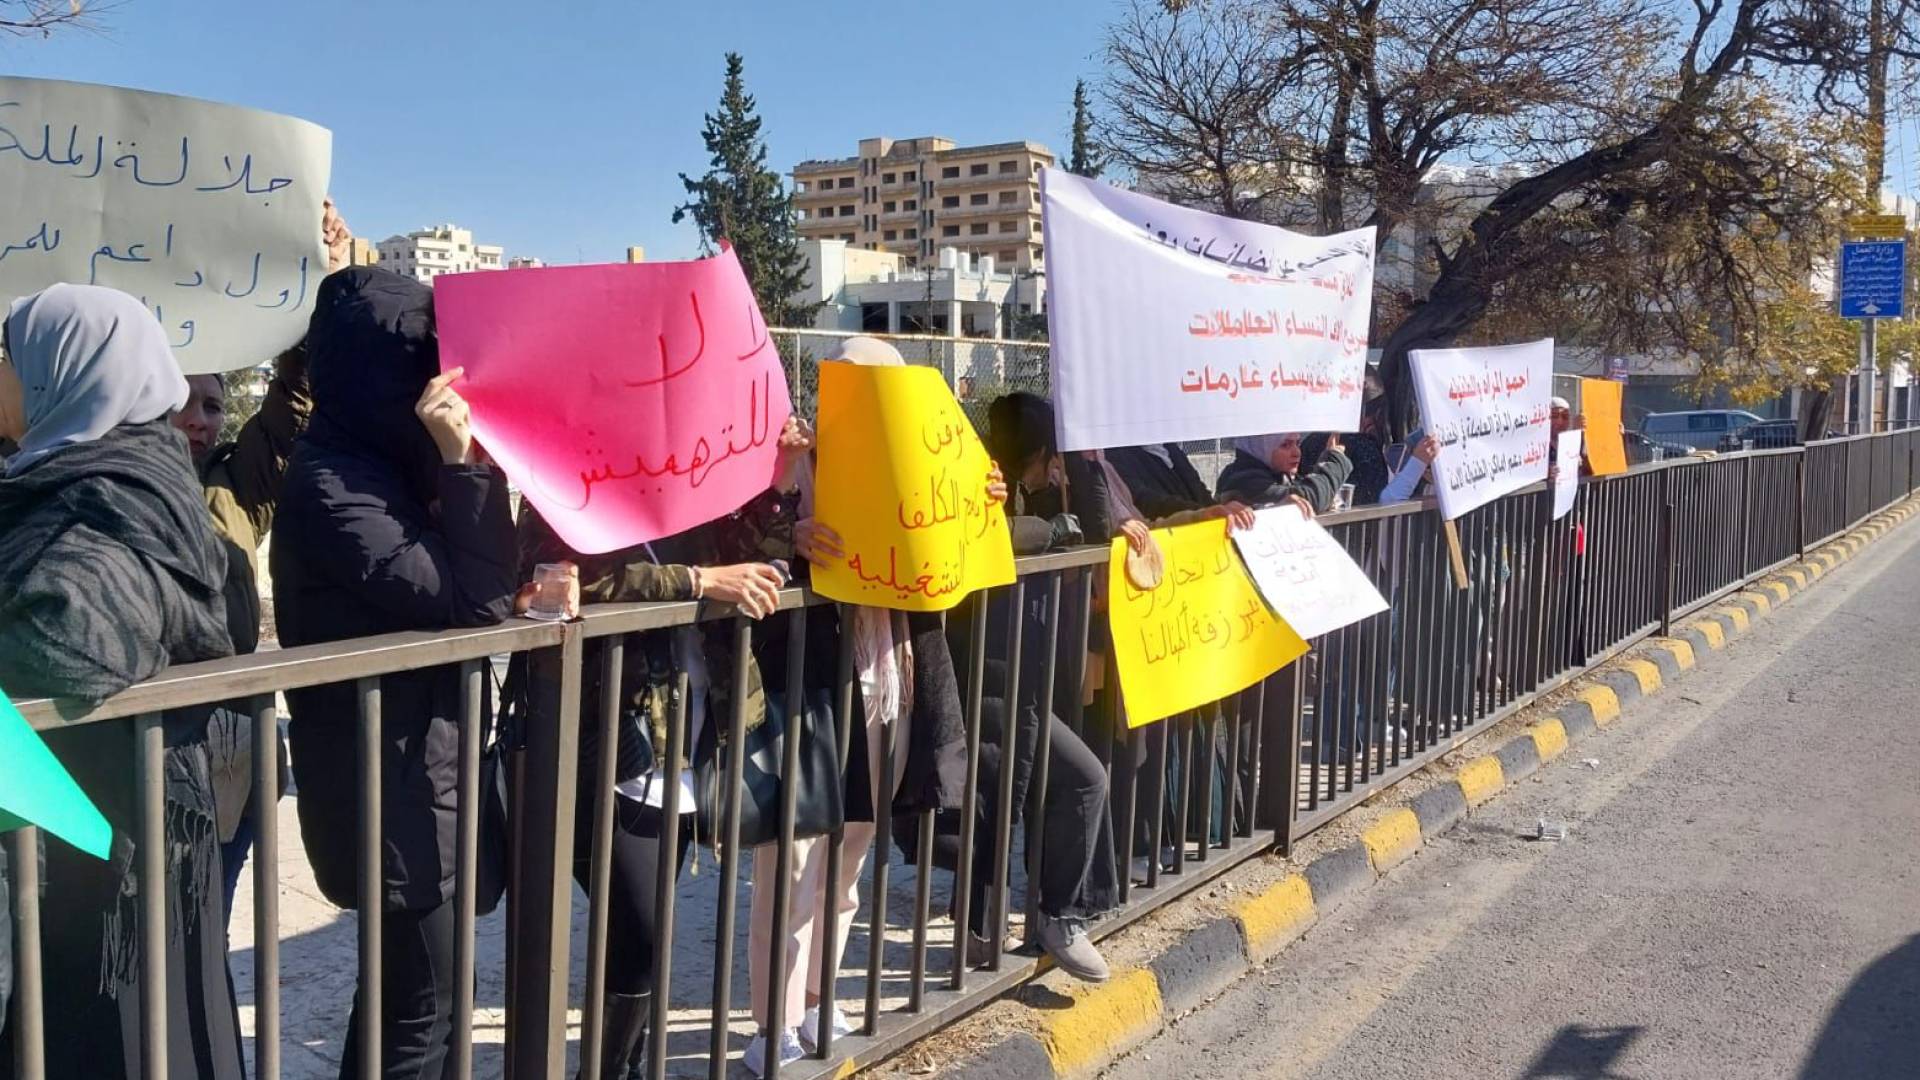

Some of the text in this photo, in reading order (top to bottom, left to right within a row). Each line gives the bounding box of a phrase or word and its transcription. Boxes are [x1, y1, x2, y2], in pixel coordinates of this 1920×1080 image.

[623, 290, 705, 388] لا
[1180, 360, 1264, 398] غارمات
[529, 370, 770, 512] للتهميش
[1212, 540, 1232, 575] لا
